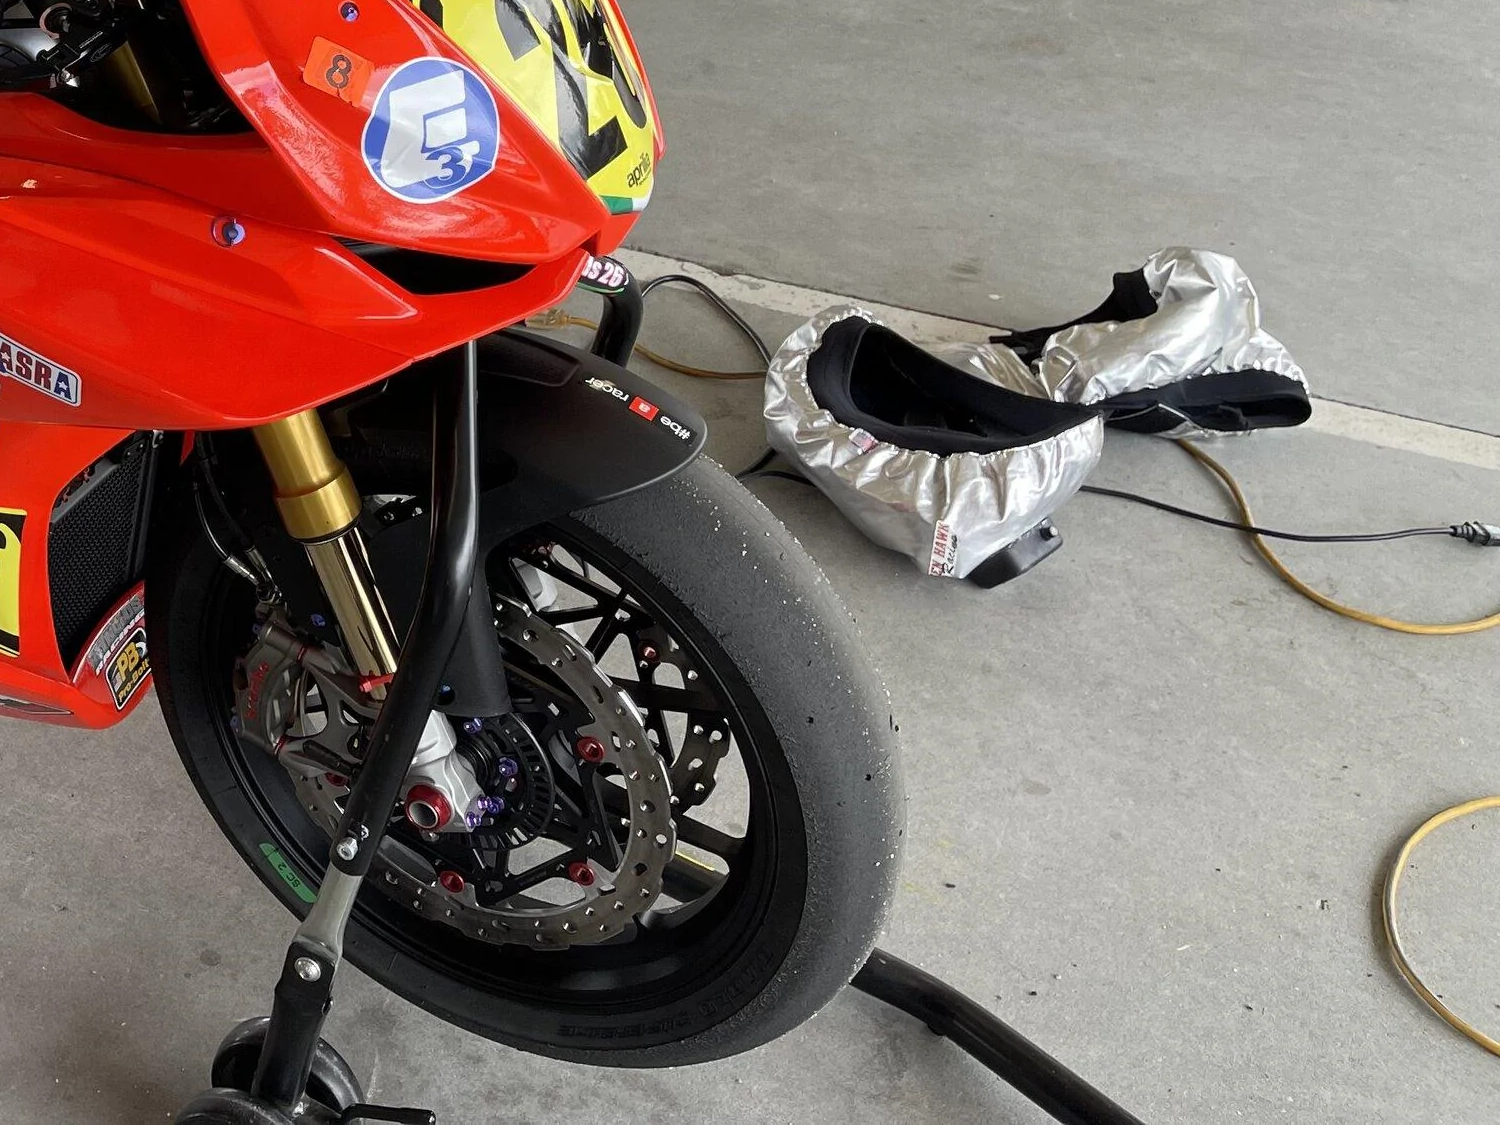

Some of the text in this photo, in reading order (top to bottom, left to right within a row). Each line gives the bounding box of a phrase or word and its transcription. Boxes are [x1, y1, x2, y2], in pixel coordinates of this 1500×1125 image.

[326, 54, 352, 89] 8
[585, 377, 629, 402] racer
[934, 522, 949, 558] HAWK
[116, 642, 141, 682] PB
